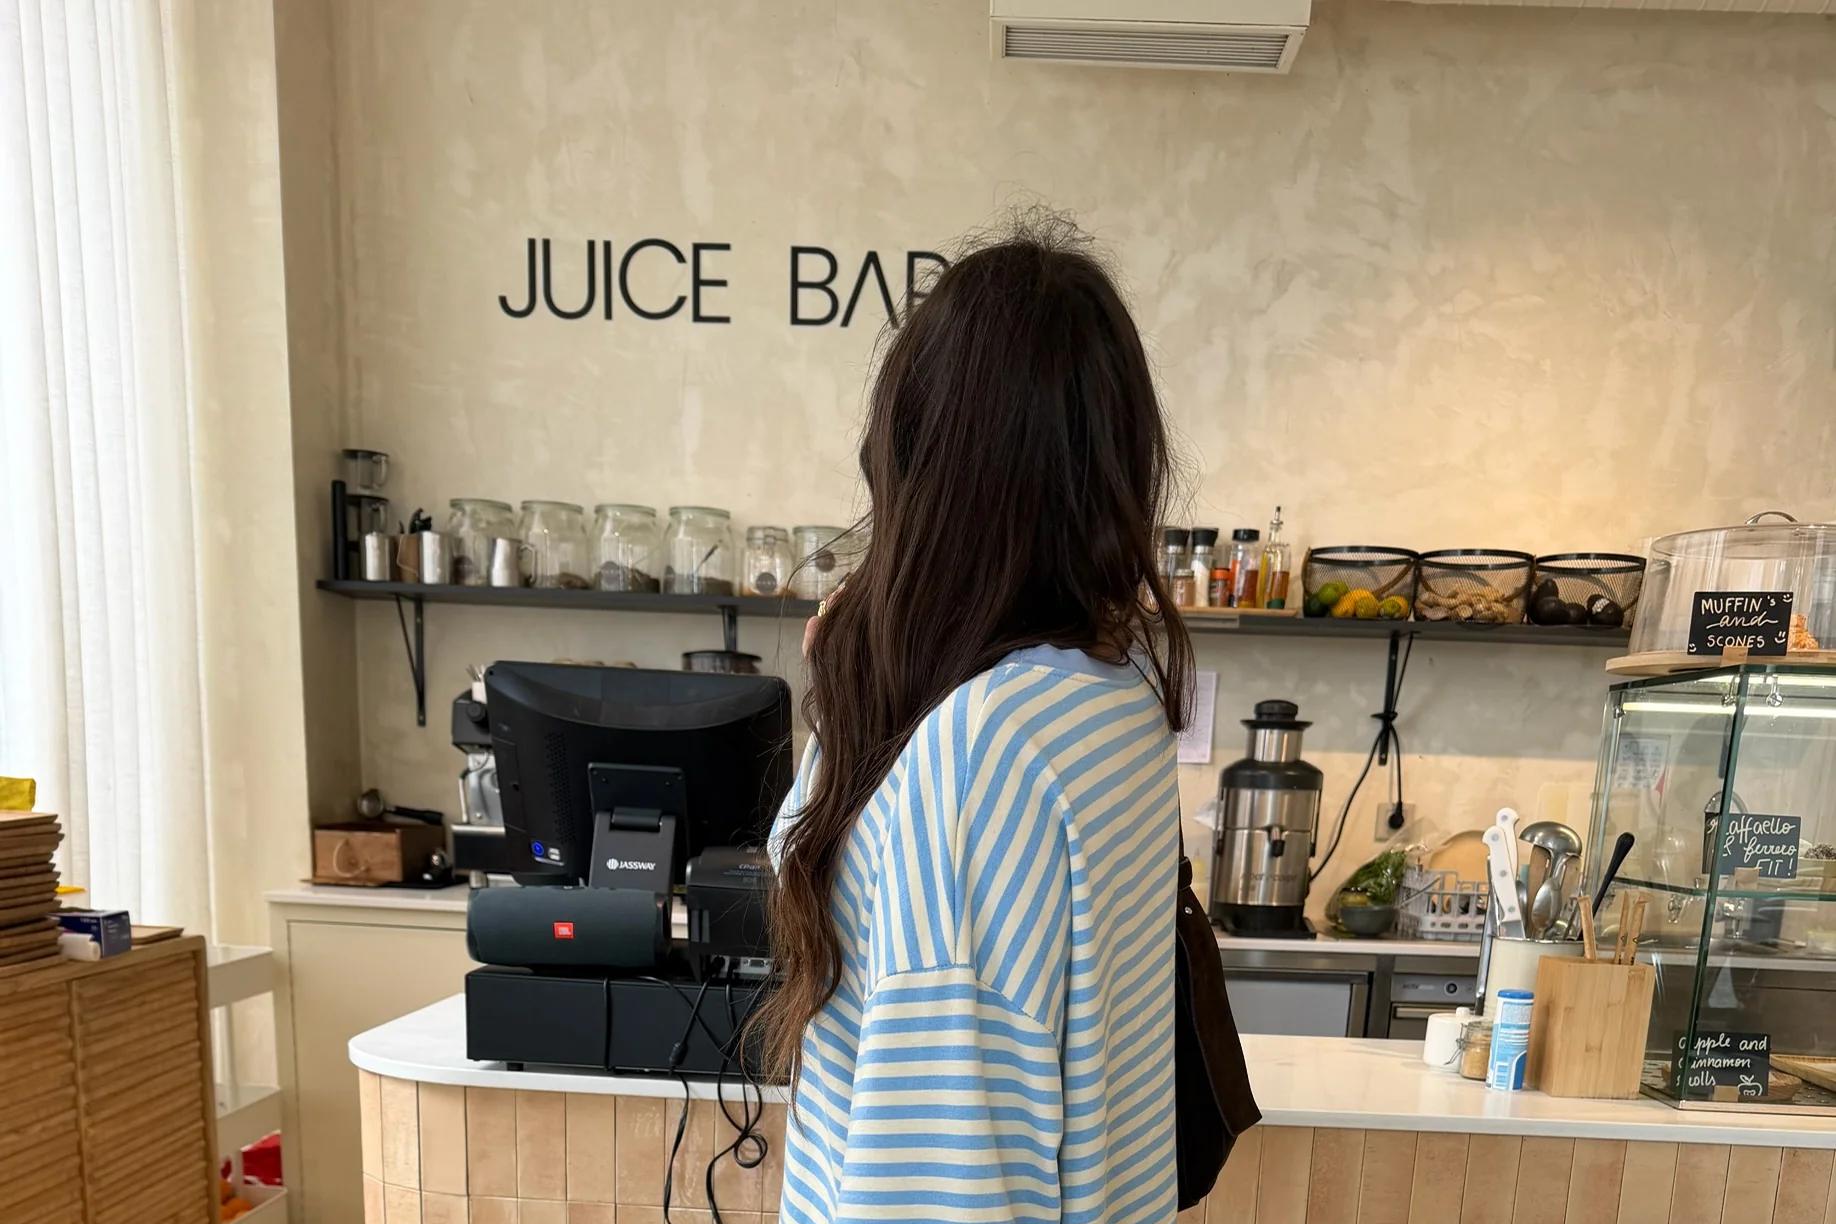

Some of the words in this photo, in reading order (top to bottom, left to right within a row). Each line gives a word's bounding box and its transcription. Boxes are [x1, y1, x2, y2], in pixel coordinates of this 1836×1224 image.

[498, 237, 731, 324] JUICE
[1706, 611, 1778, 629] and
[1707, 634, 1765, 648] SCONES
[1743, 836, 1797, 863] ferrero
[619, 860, 656, 871] JASSWAY
[1739, 1036, 1767, 1051] and
